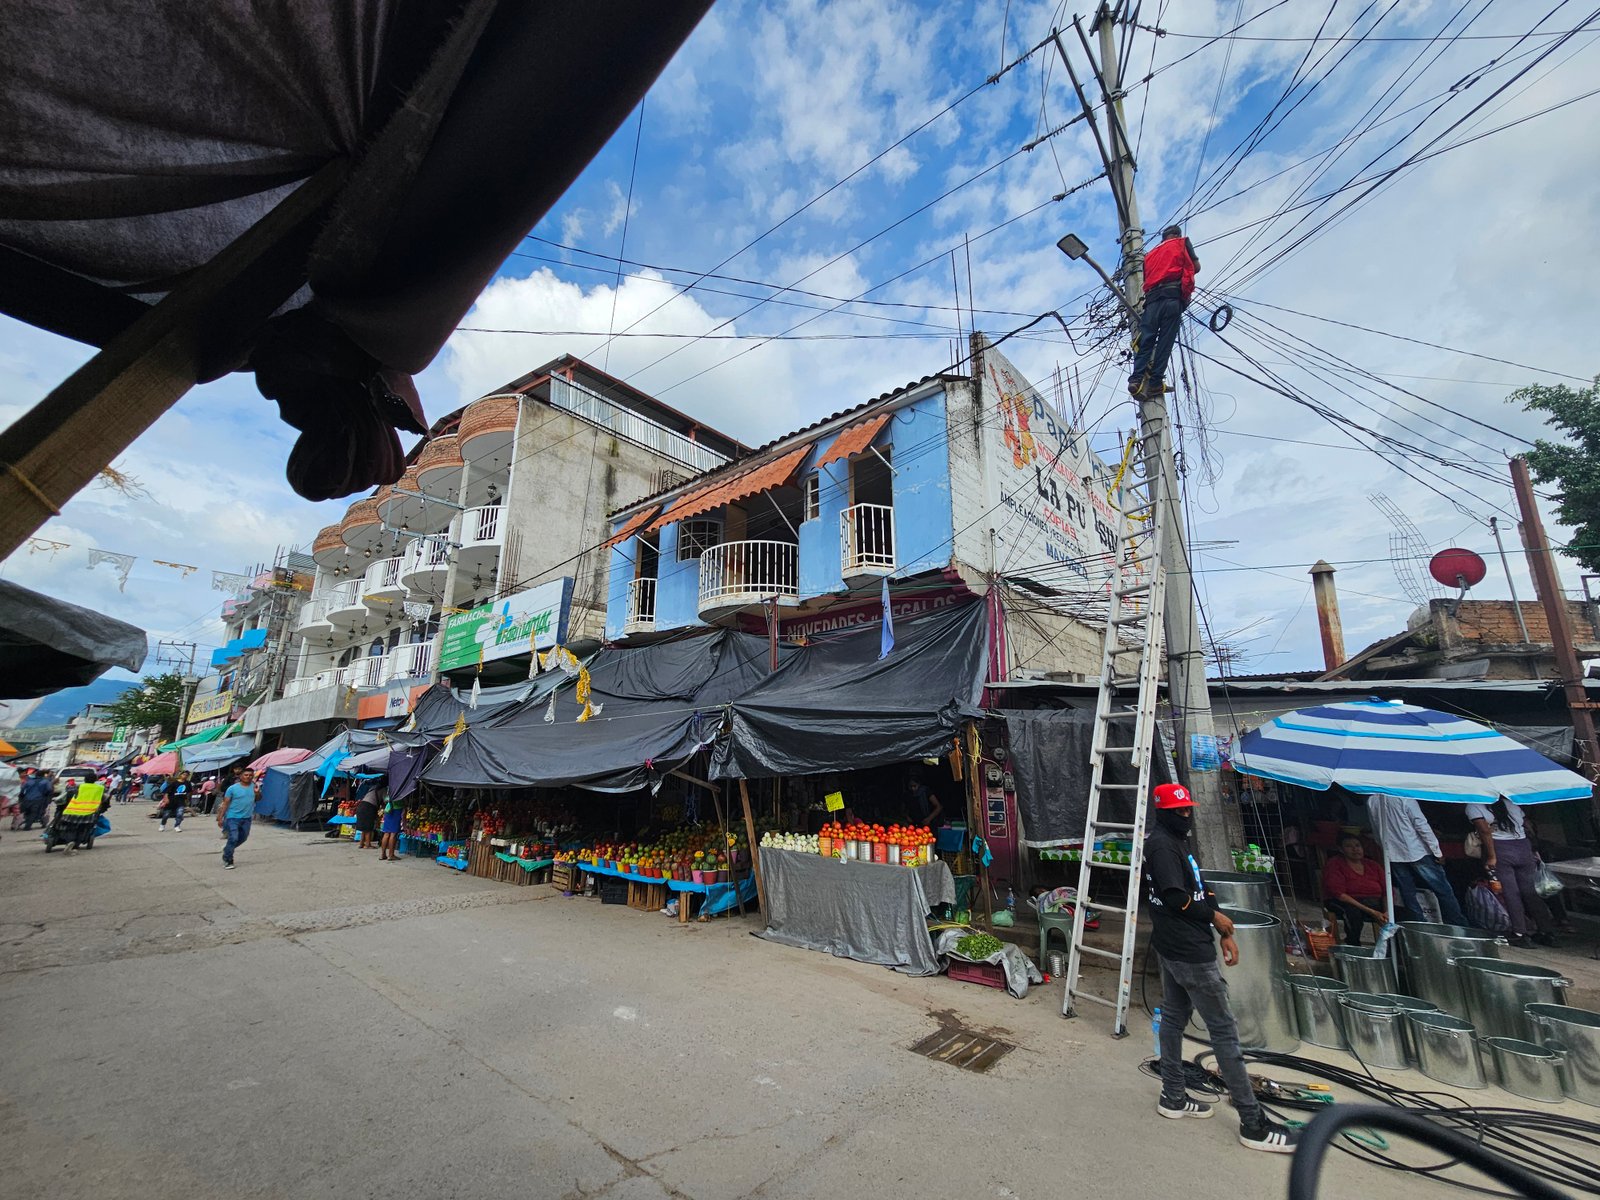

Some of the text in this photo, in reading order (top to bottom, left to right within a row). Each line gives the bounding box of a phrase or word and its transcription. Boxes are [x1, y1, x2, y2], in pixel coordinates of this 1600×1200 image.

[1035, 465, 1061, 511] LA
[1043, 506, 1077, 541] COPIAS
[448, 609, 485, 629] FARMACIA
[787, 613, 866, 641] NOVEDADES
[892, 594, 957, 617] EGALOS
